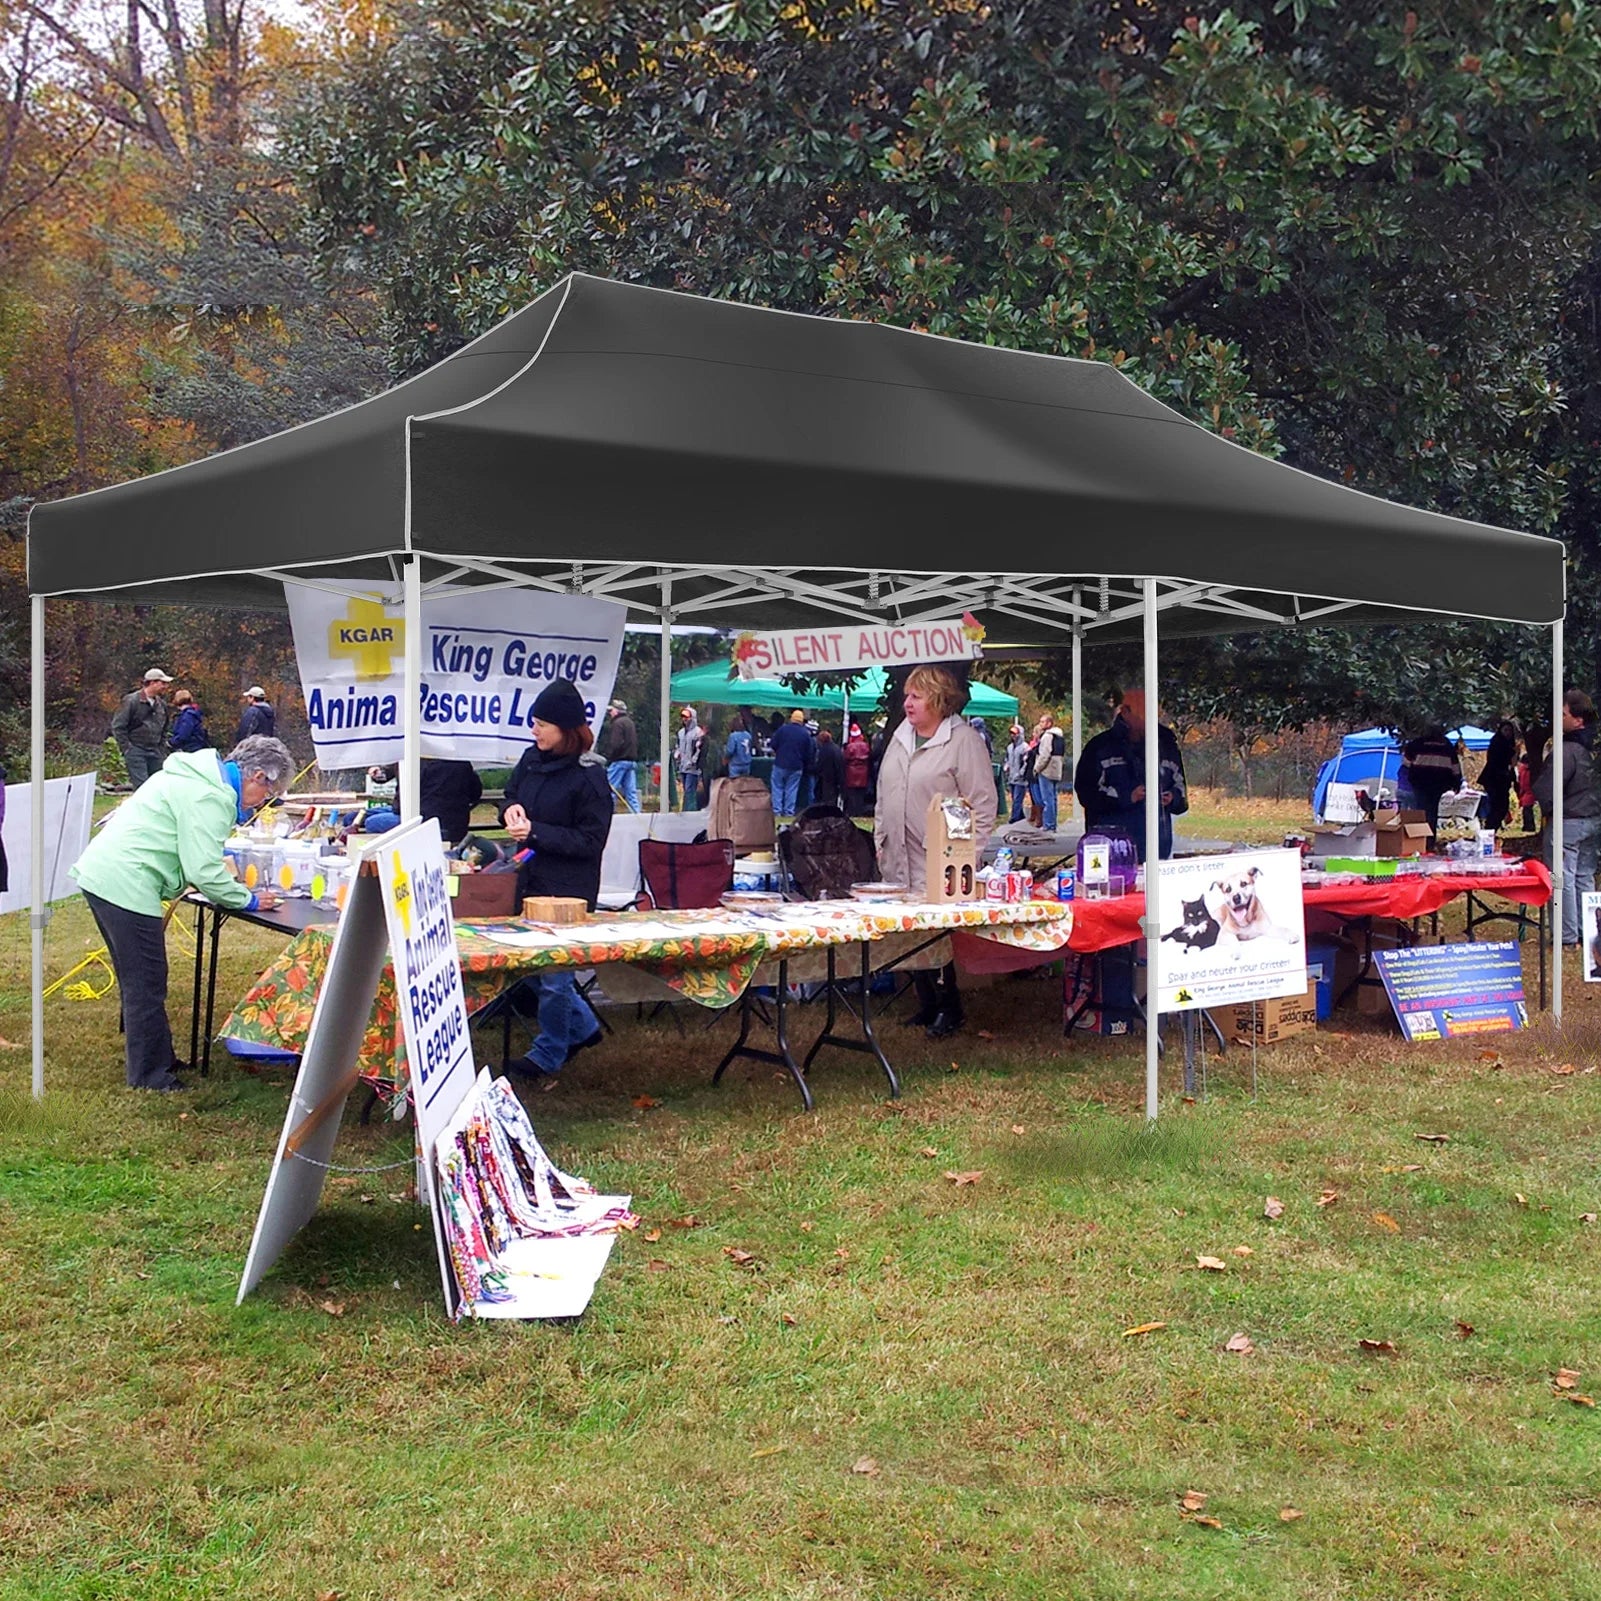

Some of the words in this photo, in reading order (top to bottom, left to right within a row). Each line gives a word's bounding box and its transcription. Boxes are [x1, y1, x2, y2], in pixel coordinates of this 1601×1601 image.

[340, 628, 394, 644] KGAR
[432, 634, 493, 682] King
[503, 640, 597, 683] George
[755, 634, 843, 669] SILENT
[858, 627, 965, 661] AUCTION
[309, 686, 397, 730] Anima
[405, 904, 452, 985] Animal
[1168, 971, 1188, 983] Spay
[1190, 969, 1207, 979] and
[1208, 965, 1238, 977] neuter
[1240, 963, 1259, 974] your
[409, 959, 457, 1034] Rescue
[416, 1004, 463, 1085] League
